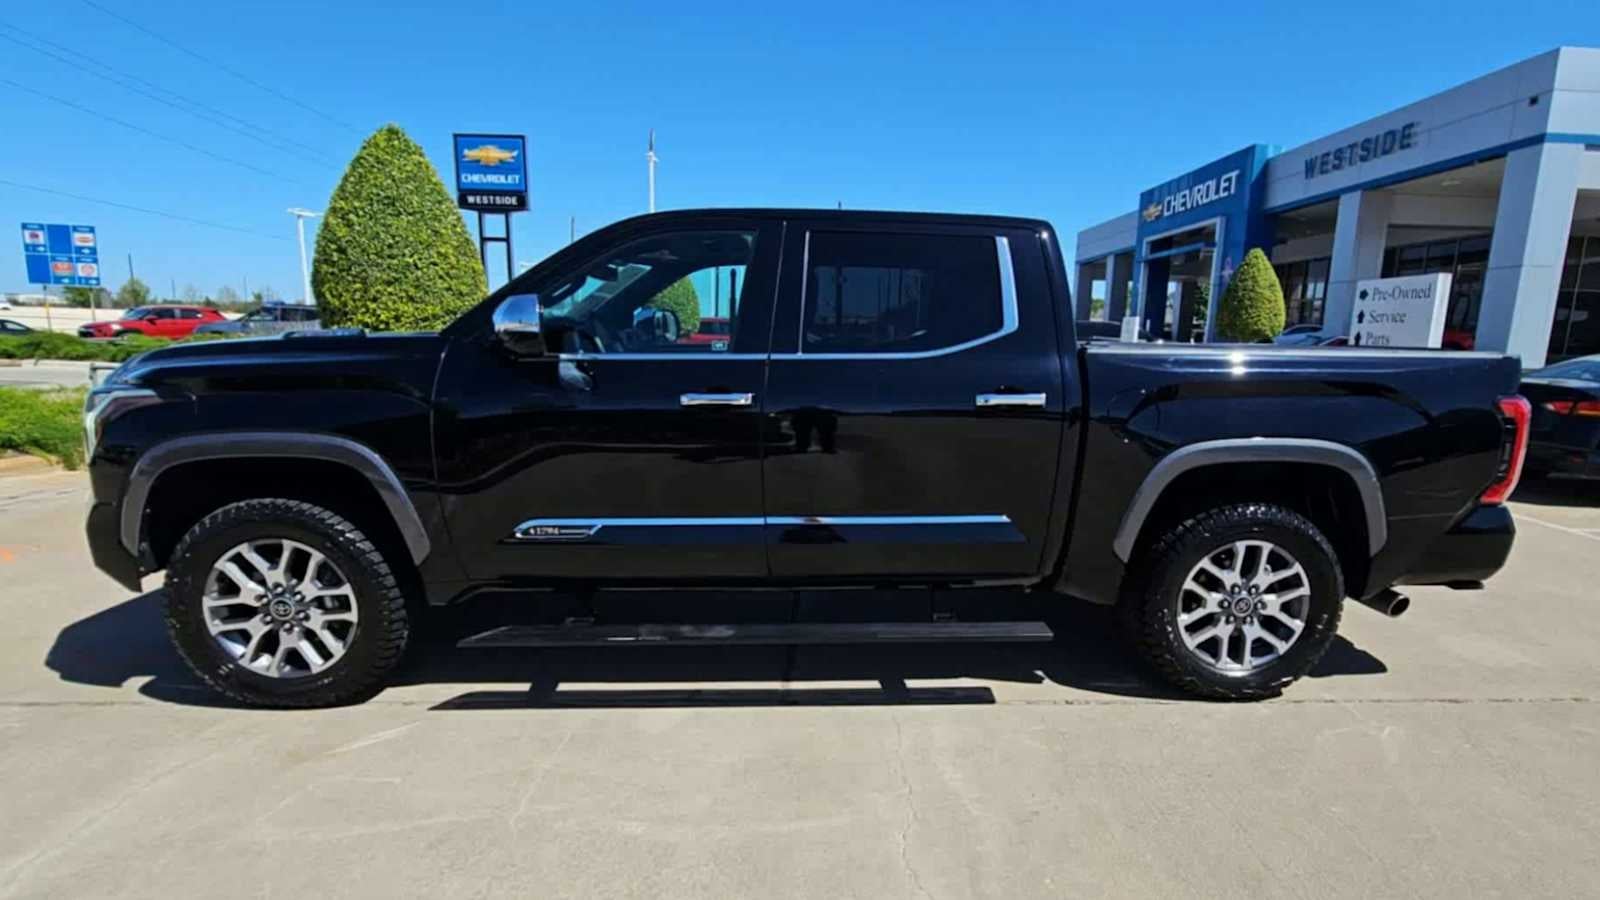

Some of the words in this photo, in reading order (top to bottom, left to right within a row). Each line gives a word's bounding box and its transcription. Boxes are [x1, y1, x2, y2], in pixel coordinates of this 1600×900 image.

[1304, 122, 1417, 179] WESTSIDE
[462, 174, 520, 184] CHEVROLET
[466, 195, 518, 205] WESTSIDE
[1163, 170, 1240, 217] CHEVROLET
[1372, 283, 1431, 301] Pre-Owned
[1368, 310, 1407, 323] Service
[1365, 331, 1390, 345] Parts
